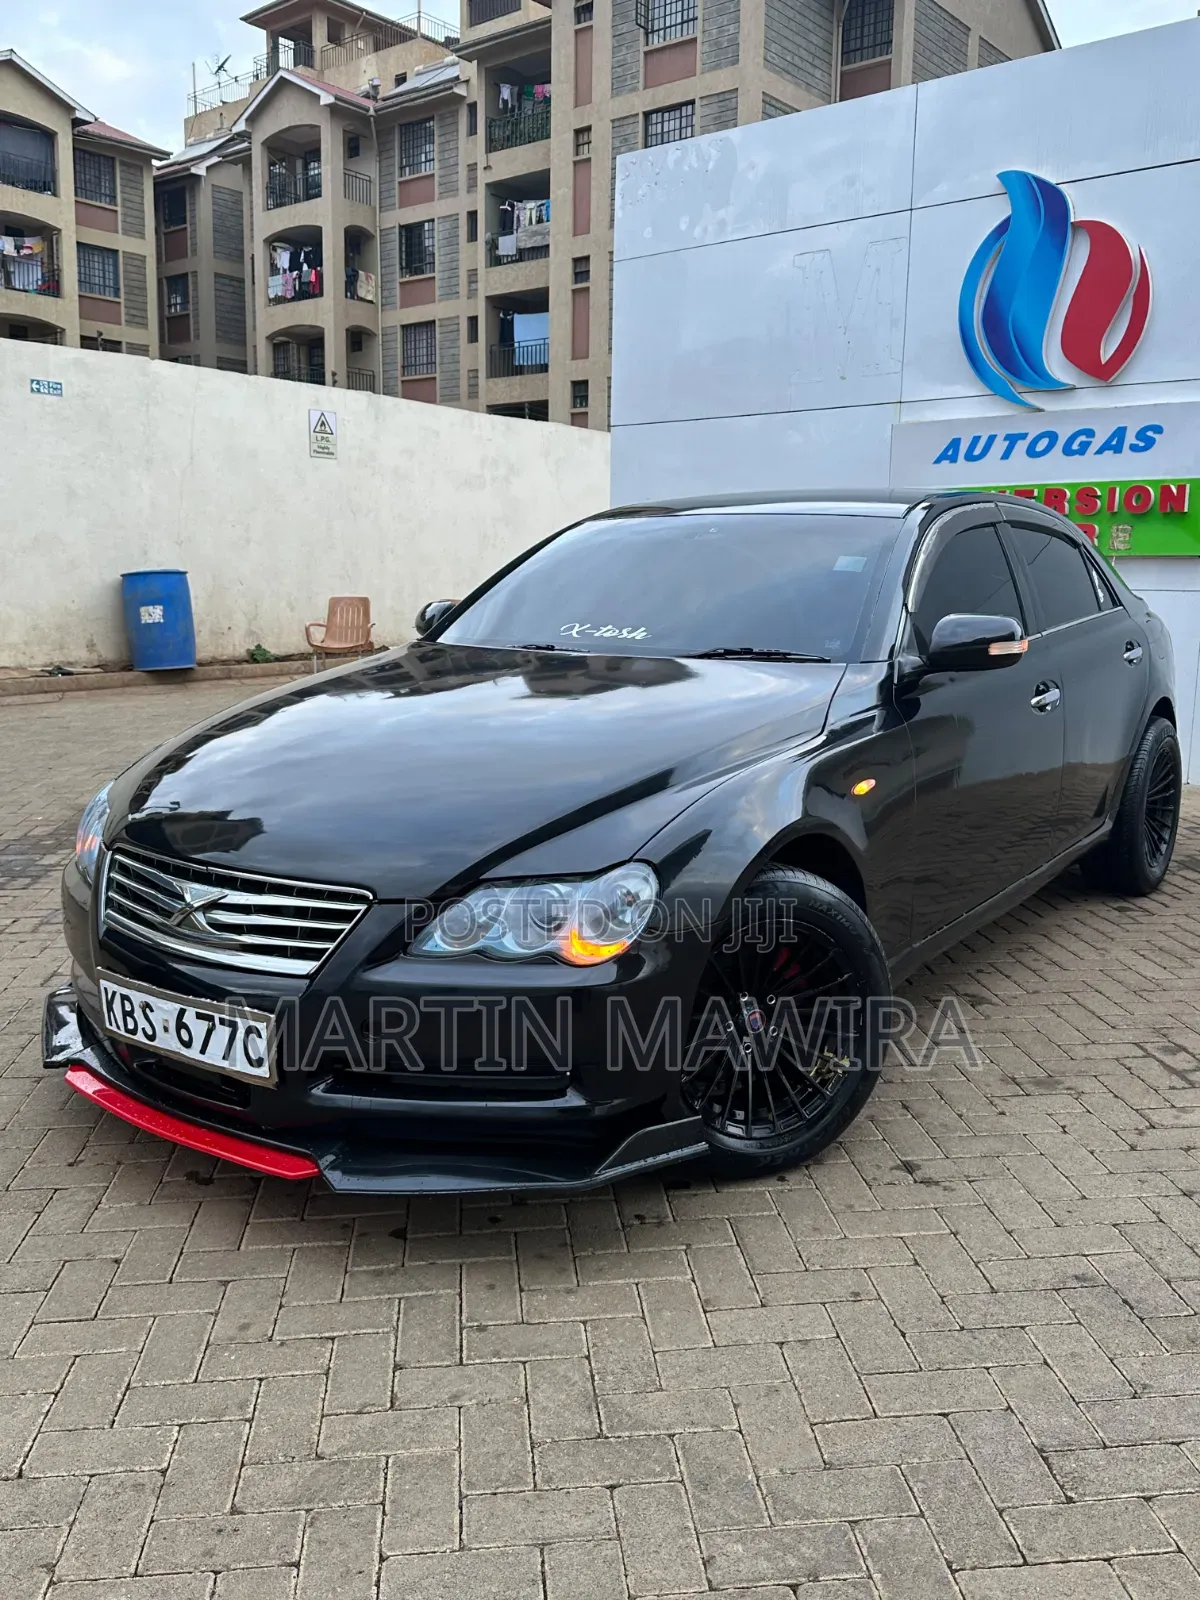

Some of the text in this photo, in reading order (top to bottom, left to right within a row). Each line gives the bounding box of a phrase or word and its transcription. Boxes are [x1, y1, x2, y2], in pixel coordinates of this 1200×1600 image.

[932, 423, 1164, 464] AUTOGAS
[103, 986, 265, 1069] KBS 677C
